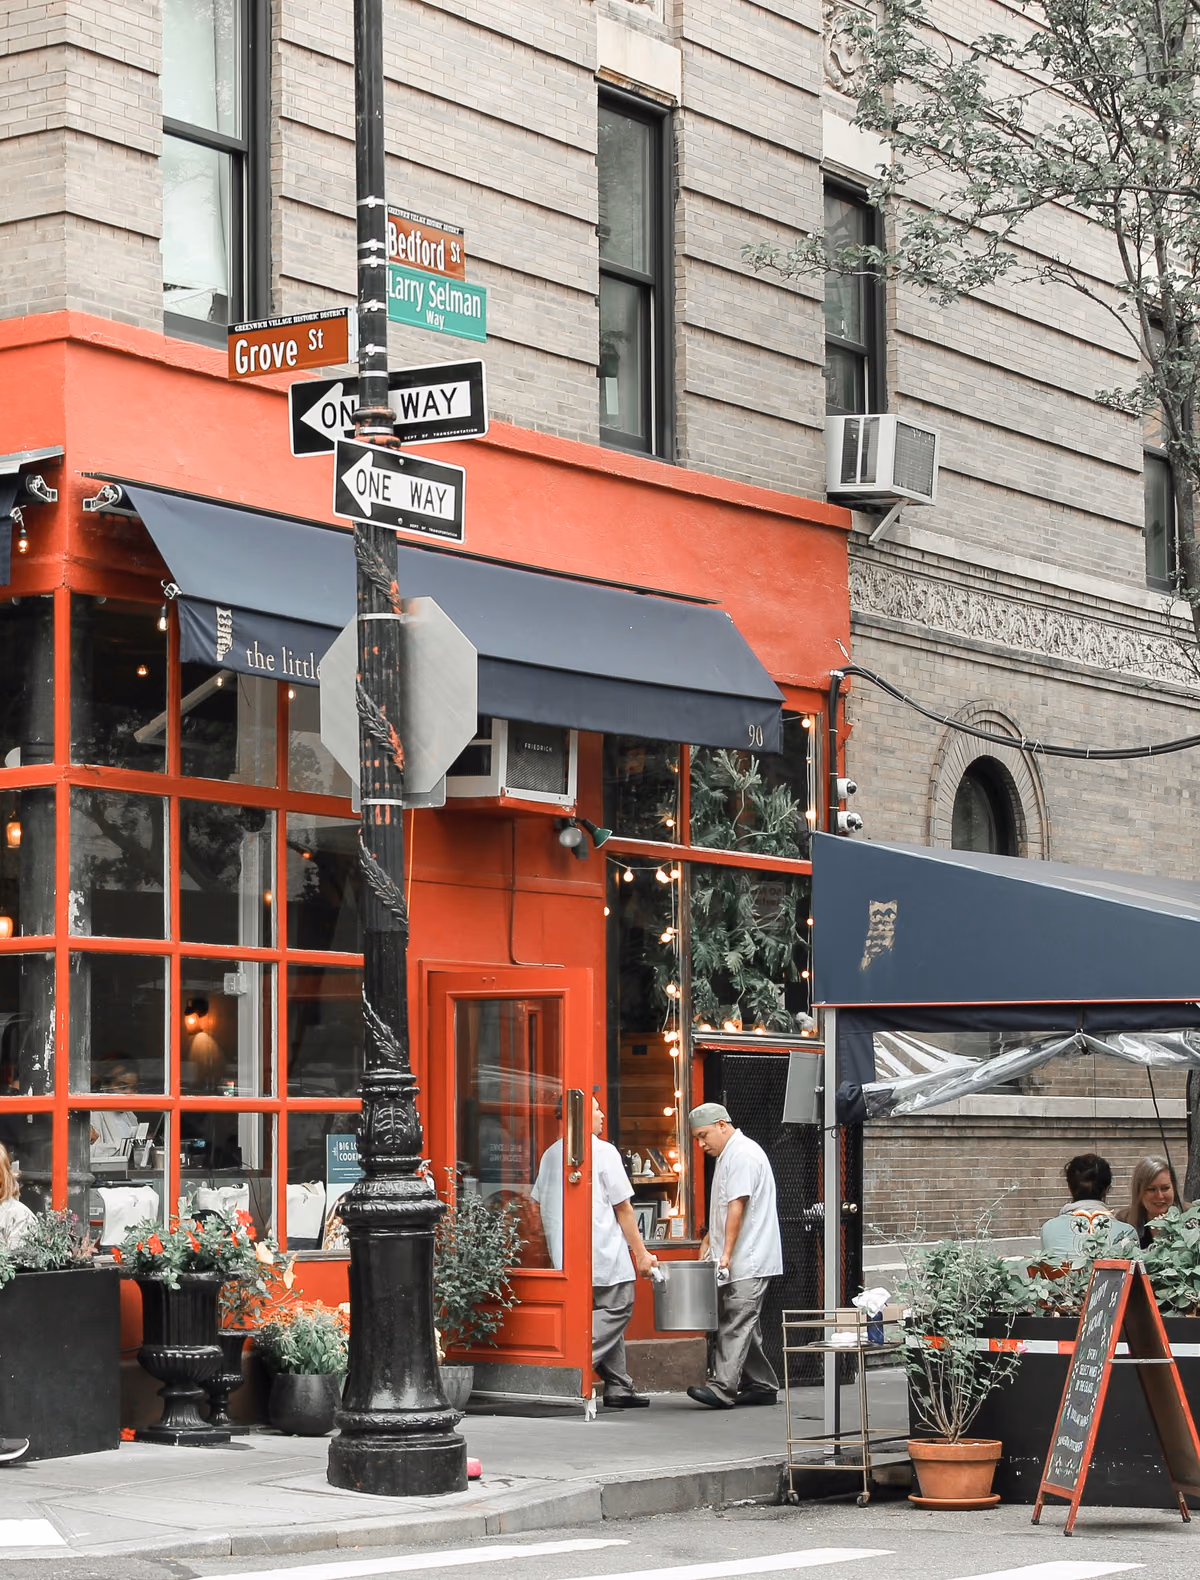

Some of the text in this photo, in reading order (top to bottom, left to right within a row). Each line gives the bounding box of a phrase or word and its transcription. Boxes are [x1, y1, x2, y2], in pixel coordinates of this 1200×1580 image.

[388, 220, 461, 271] Bedford St
[388, 269, 481, 319] Larry Selman
[234, 308, 346, 332] GREENWICH VILLAGE HISTORIC DISTRICT
[426, 309, 445, 330] Way
[235, 328, 324, 374] Grove St
[321, 387, 458, 429] ON WAY
[433, 428, 478, 437] TRANSPORTATION
[355, 468, 448, 514] ONE WAY
[245, 641, 275, 671] the
[524, 742, 553, 752] FRIEDRICH
[748, 724, 763, 747] 90
[339, 1141, 350, 1150] BIG
[1087, 1279, 1109, 1312] HAPPY
[1086, 1309, 1104, 1337] HOUR
